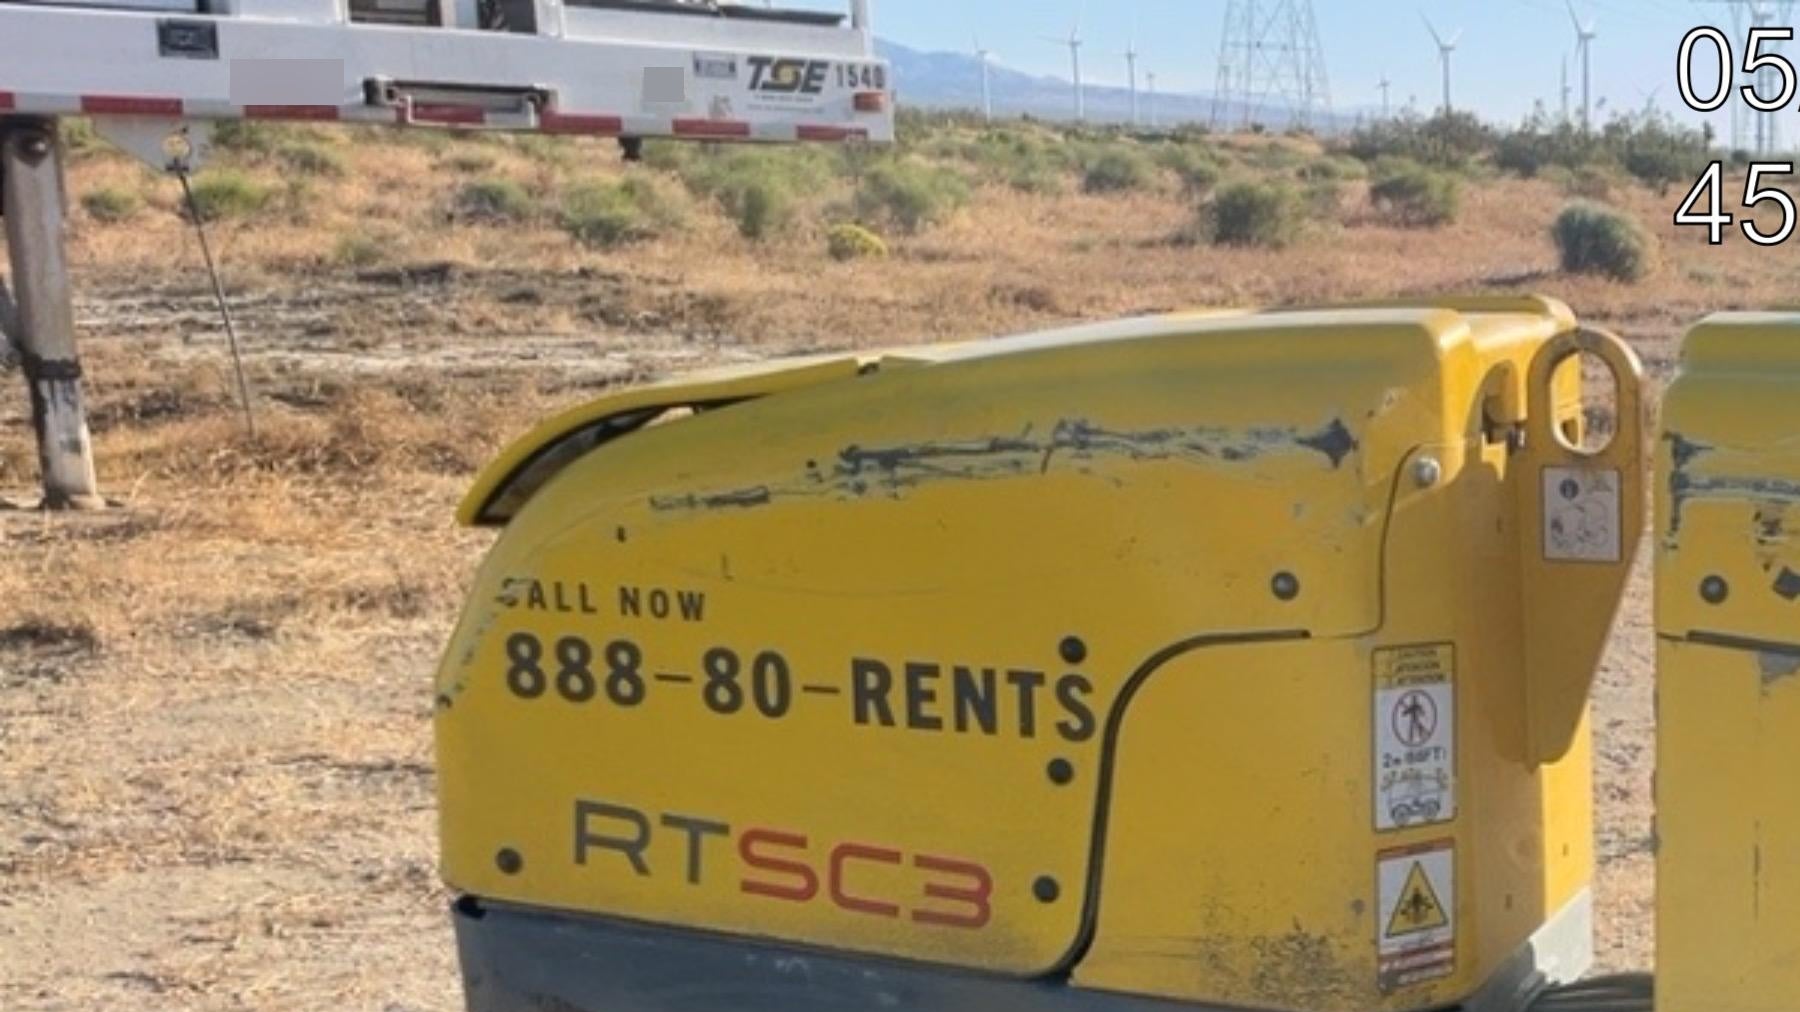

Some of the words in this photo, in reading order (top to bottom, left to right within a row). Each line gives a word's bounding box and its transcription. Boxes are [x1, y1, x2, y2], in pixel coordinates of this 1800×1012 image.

[746, 55, 829, 94] TSE
[618, 585, 706, 622] NOW
[504, 631, 1097, 743] 888-80-RENTS
[573, 798, 993, 930] RTSC3
